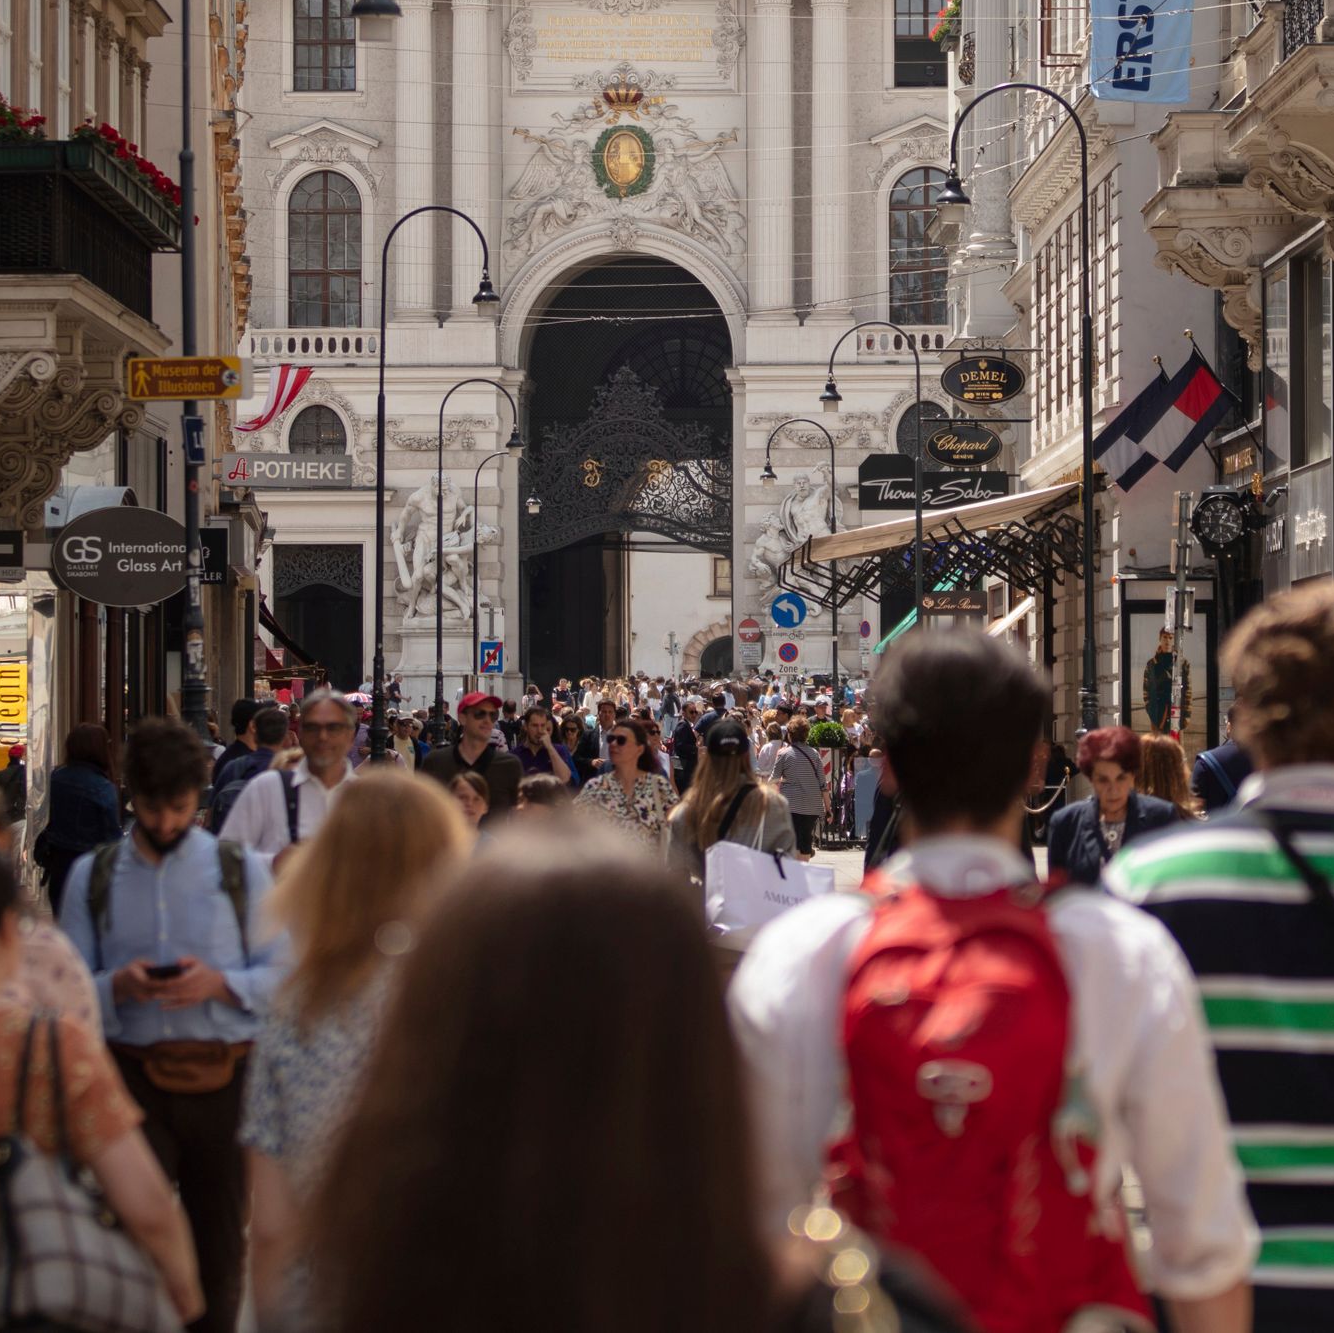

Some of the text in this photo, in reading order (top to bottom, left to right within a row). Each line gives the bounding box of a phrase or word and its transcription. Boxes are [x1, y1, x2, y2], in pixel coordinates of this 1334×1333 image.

[152, 365, 222, 377] Museum der
[959, 370, 1008, 383] DEMEL
[158, 379, 216, 392] Illusionen
[933, 434, 993, 453] Chopard
[228, 457, 347, 481] APOTHEKE
[861, 477, 1004, 505] Thoms Sabo
[108, 541, 187, 554] Internationa
[117, 558, 183, 572] Glass Art
[779, 665, 798, 673] Zone
